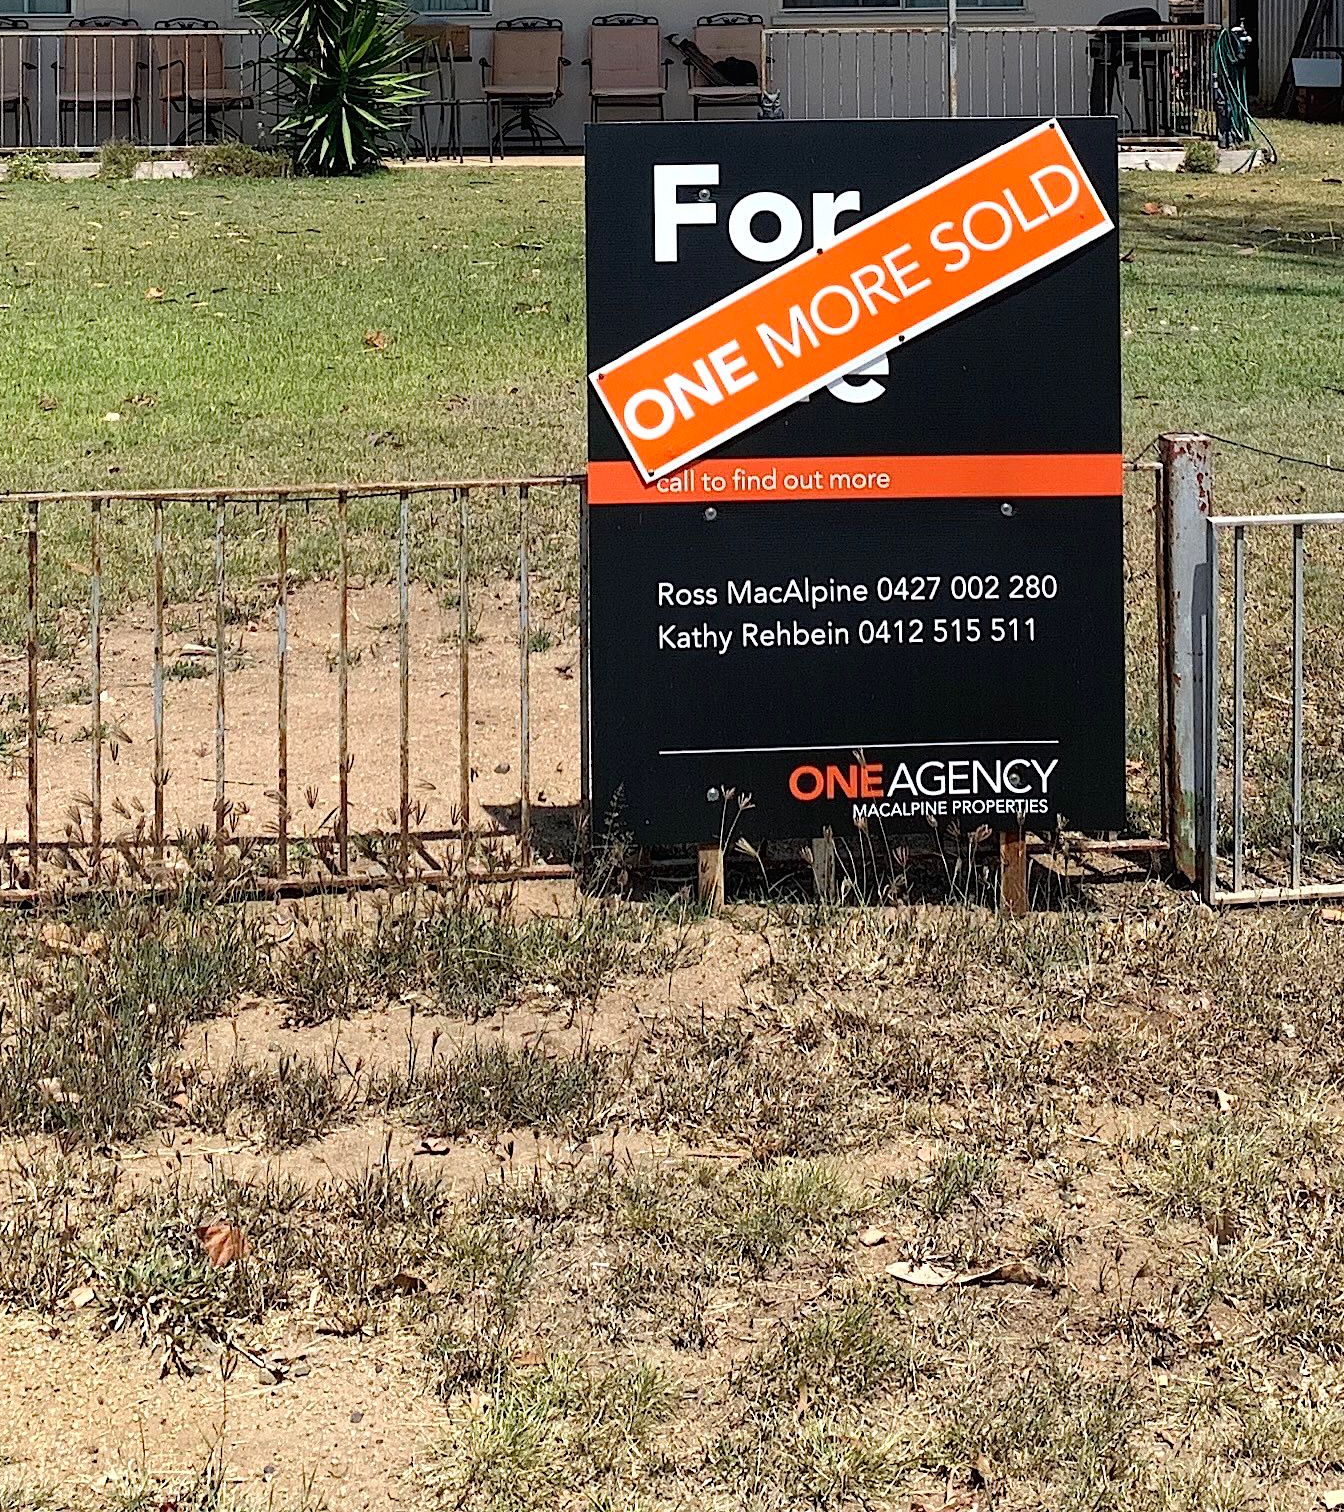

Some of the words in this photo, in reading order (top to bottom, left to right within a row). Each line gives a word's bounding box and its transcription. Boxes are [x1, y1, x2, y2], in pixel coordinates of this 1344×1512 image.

[653, 164, 861, 263] For
[623, 339, 759, 440] ONE
[755, 244, 932, 369] MORE
[929, 164, 1080, 273] SOLD
[656, 468, 695, 493] call
[701, 470, 727, 493] to
[731, 466, 778, 492] find
[783, 468, 824, 490] out
[829, 471, 891, 489] more
[657, 582, 718, 606] Ross
[727, 577, 869, 609] MacAlpine
[876, 576, 940, 602] 0427
[950, 575, 1000, 601] 002
[1009, 574, 1058, 599] 280
[659, 623, 733, 654] Kathy
[742, 621, 850, 648] Rehbein
[858, 620, 924, 644] 0412
[933, 619, 982, 643] 515
[990, 618, 1037, 641] 511
[852, 801, 948, 818] MACALPINE
[952, 799, 1049, 815] PROPERTIES
